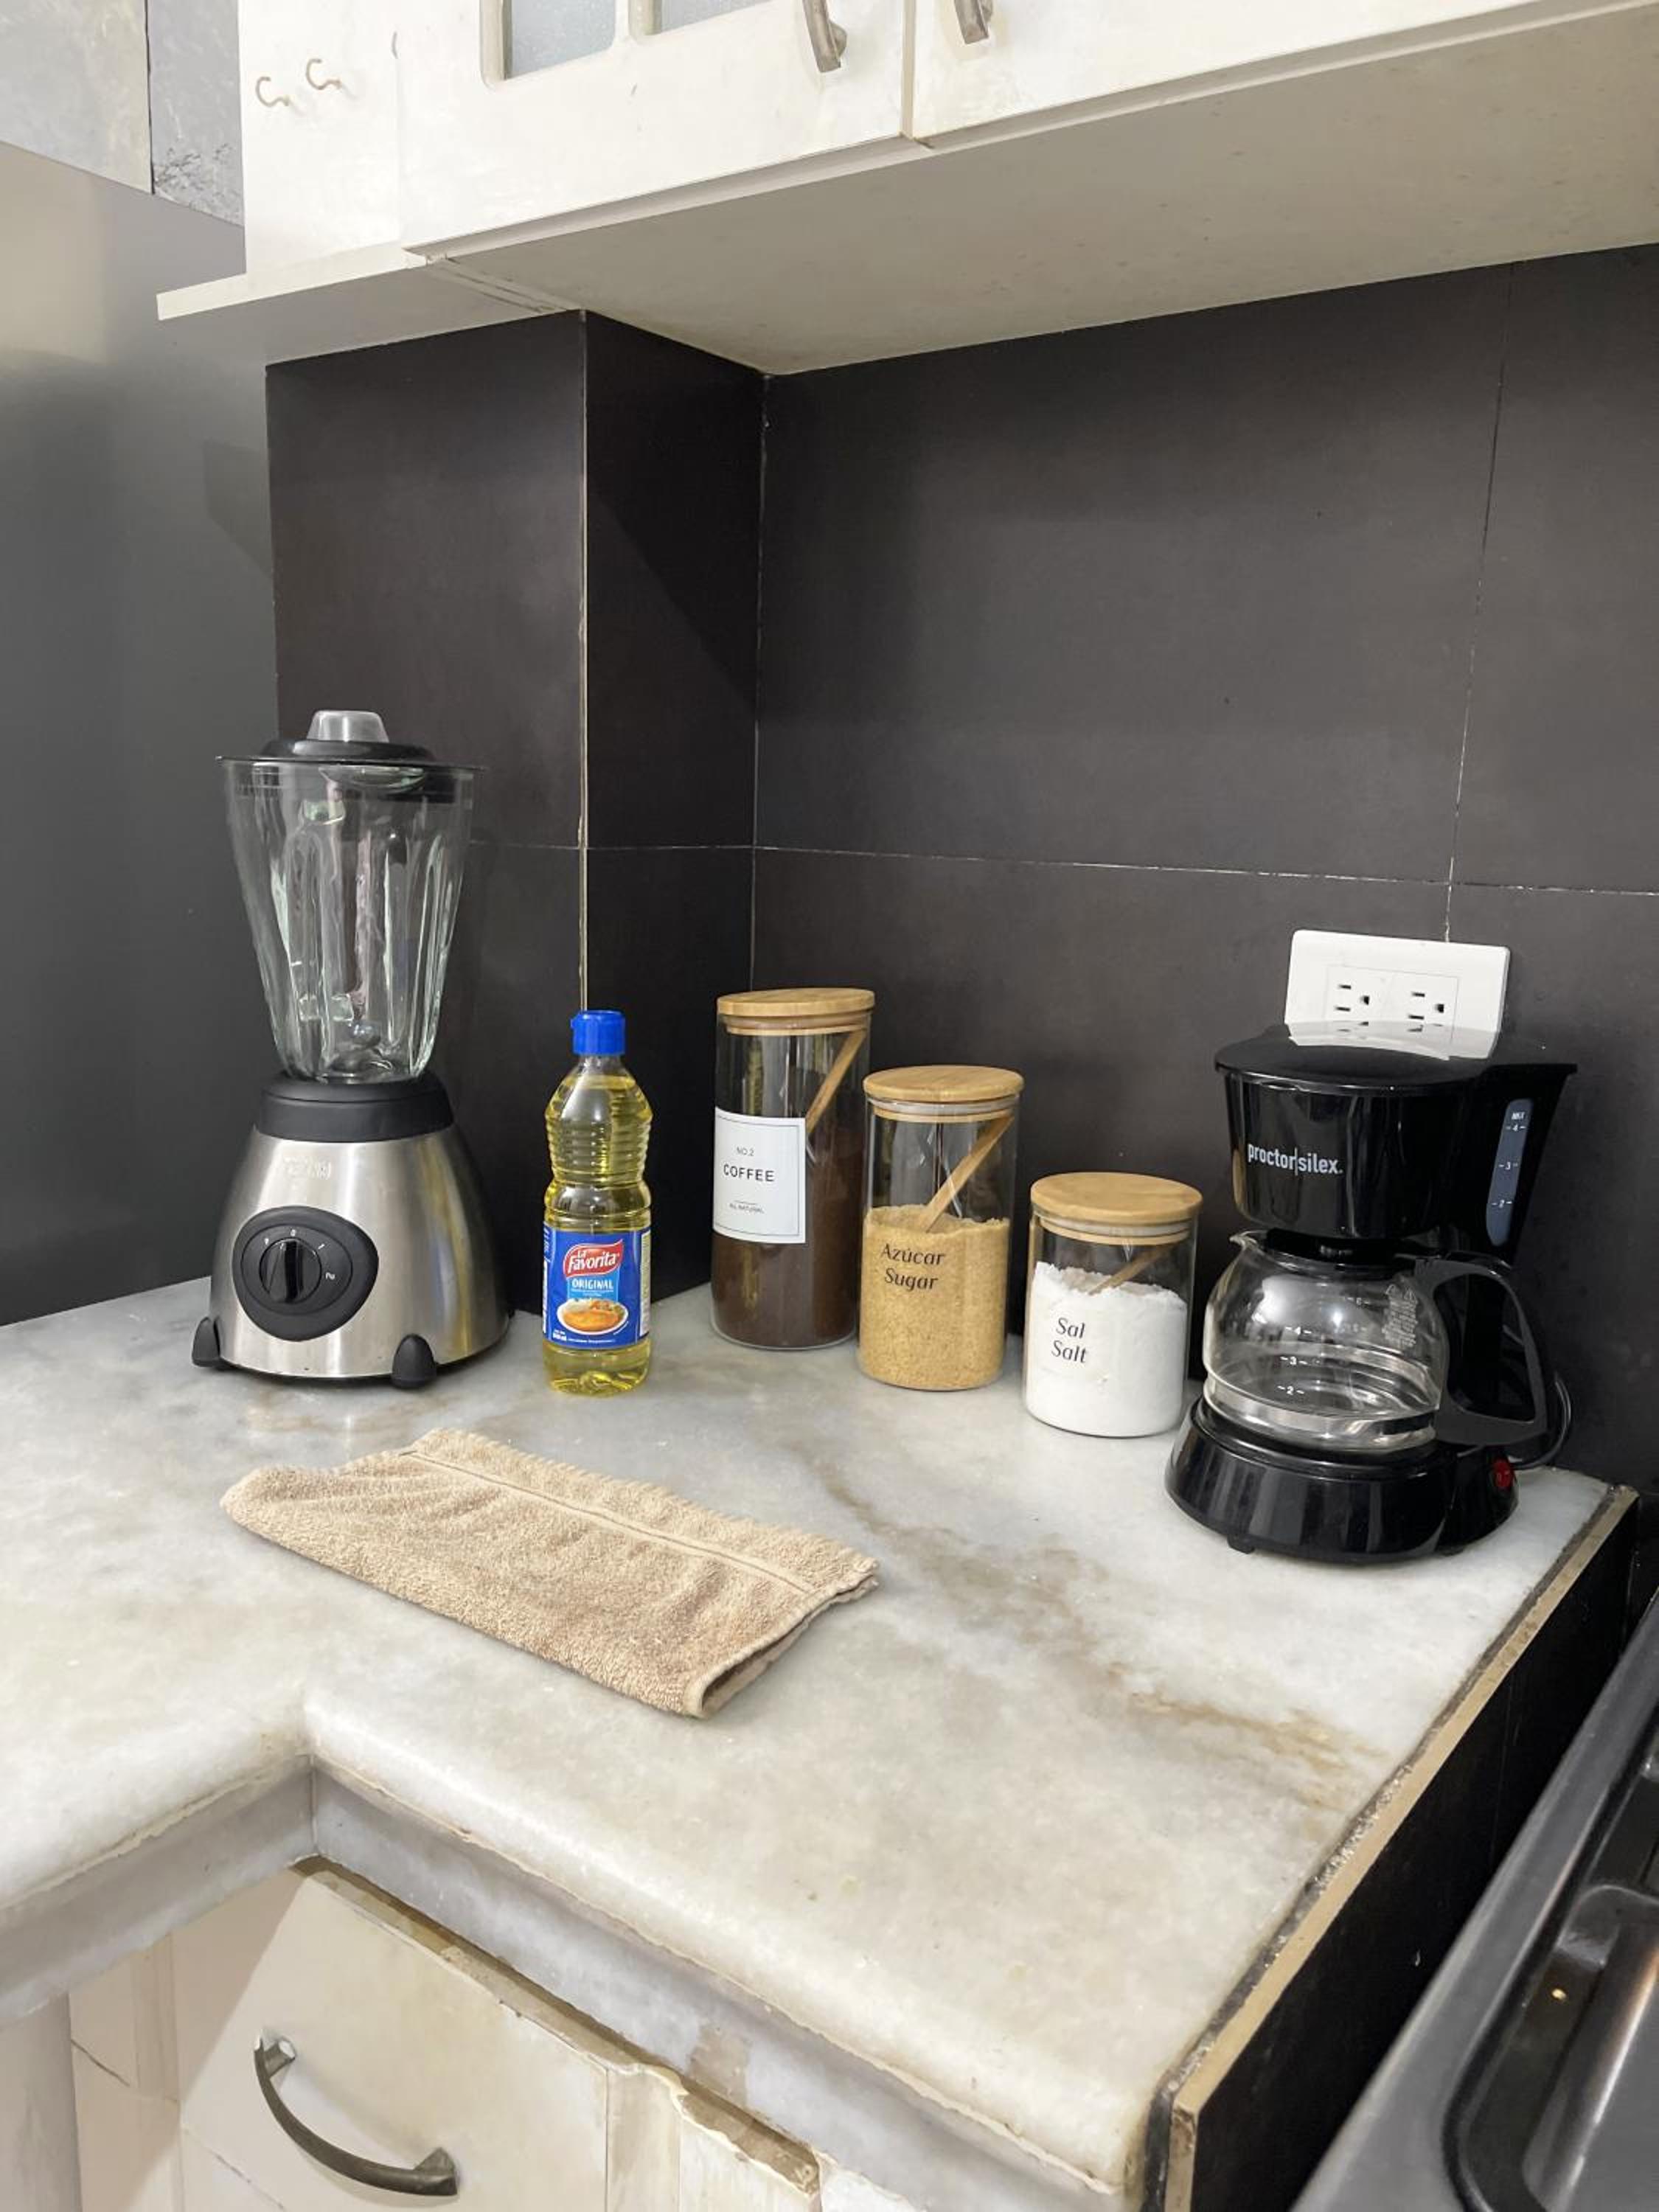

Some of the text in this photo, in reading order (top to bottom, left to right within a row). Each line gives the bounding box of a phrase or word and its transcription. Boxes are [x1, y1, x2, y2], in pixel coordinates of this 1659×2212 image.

[723, 1164, 775, 1182] COFFEE
[567, 1252, 616, 1274] Favorita
[880, 1243, 945, 1265] Azúcar
[571, 1279, 614, 1290] ORIGINAL
[884, 1267, 939, 1292] Sugar
[1055, 1317, 1086, 1339] Sal
[1051, 1340, 1089, 1363] Salt
